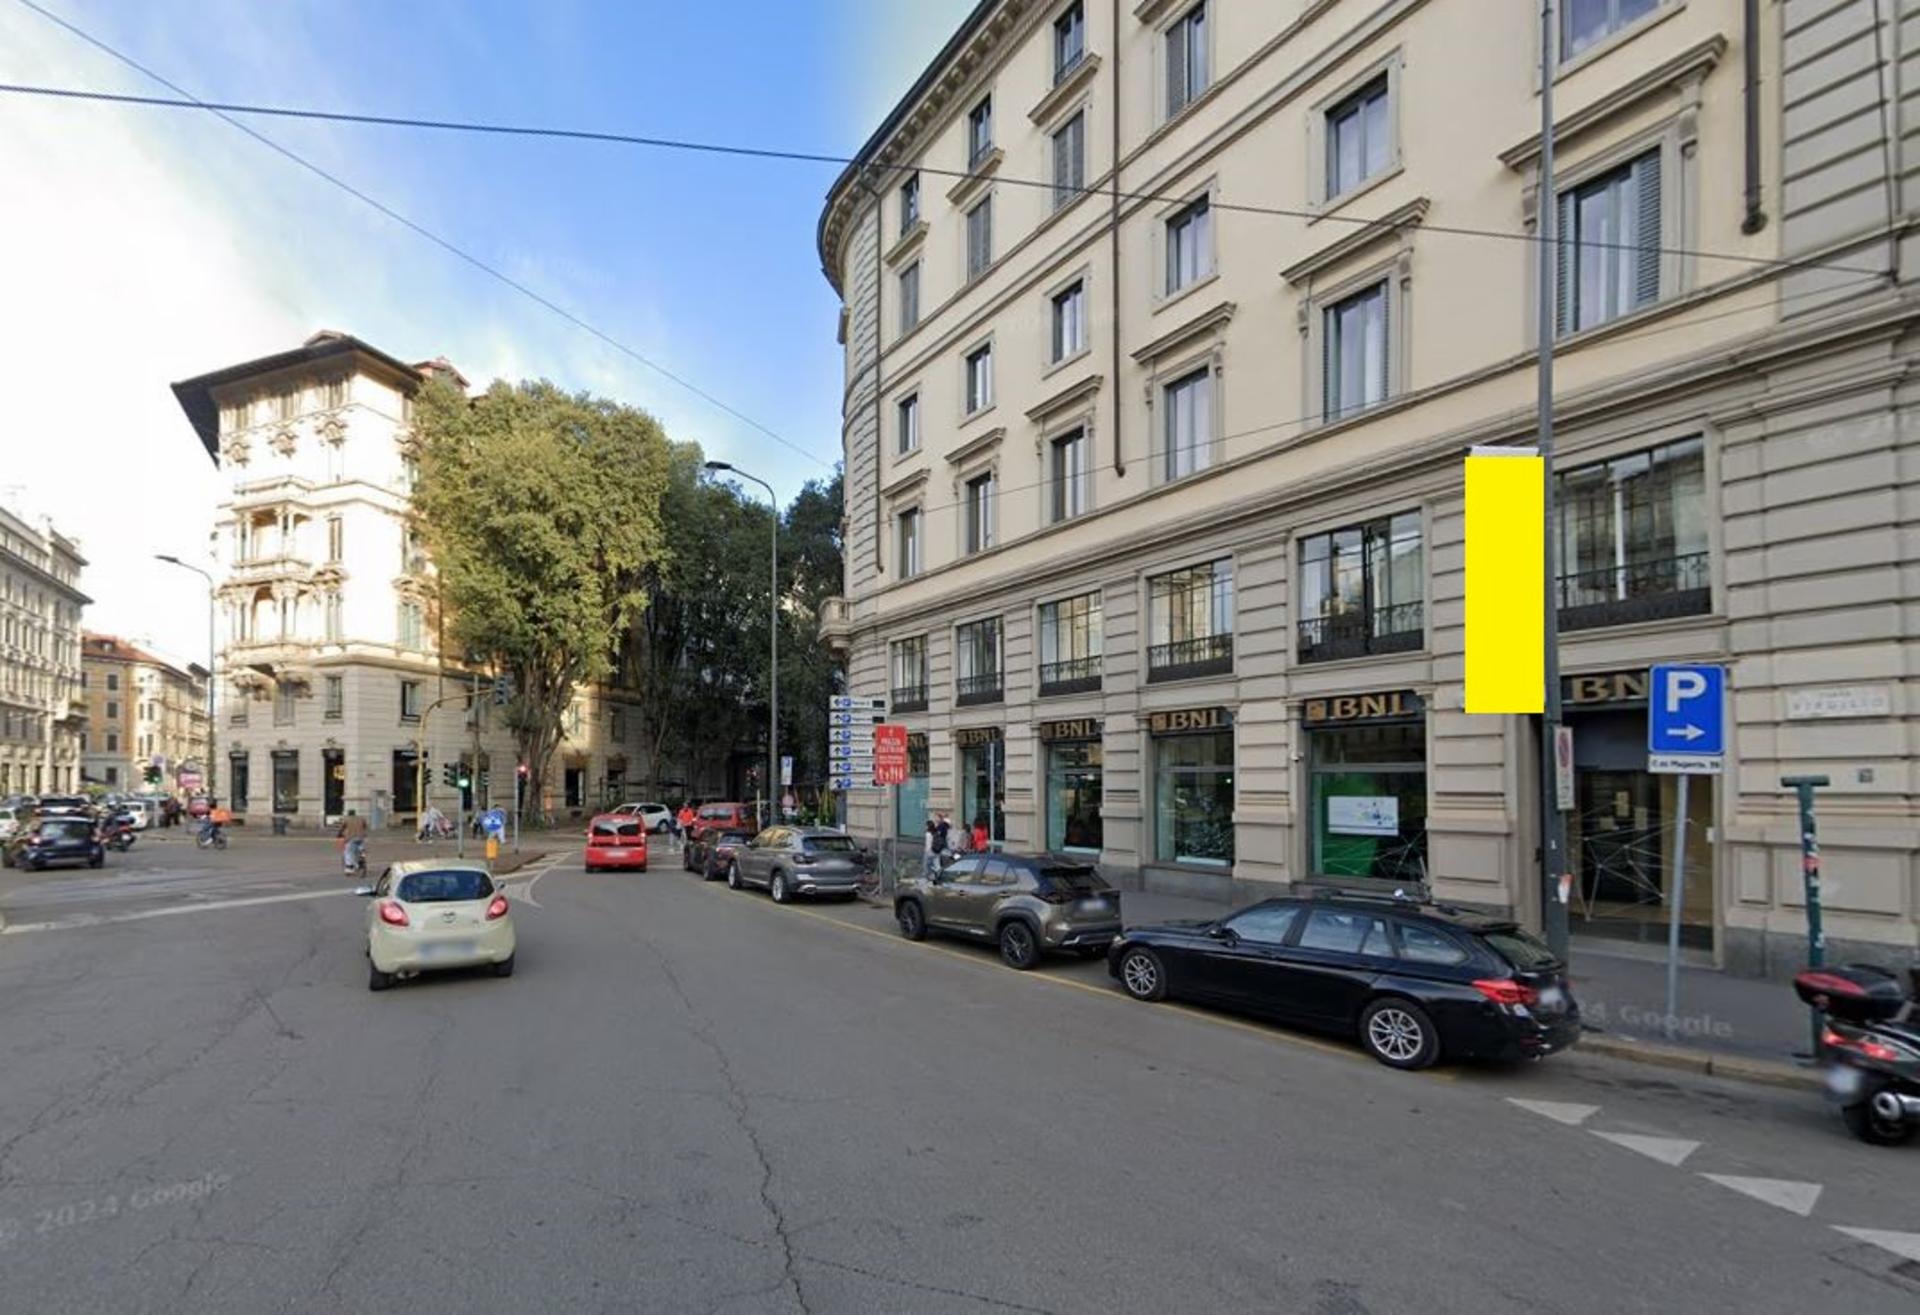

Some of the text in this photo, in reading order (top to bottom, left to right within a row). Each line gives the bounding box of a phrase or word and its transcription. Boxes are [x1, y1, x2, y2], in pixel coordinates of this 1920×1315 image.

[1572, 673, 1648, 701] BN
[1666, 671, 1707, 712] P
[1332, 692, 1414, 719] BNL
[1055, 720, 1097, 737] BNL
[1168, 708, 1226, 731] BNL
[968, 729, 998, 743] BNL
